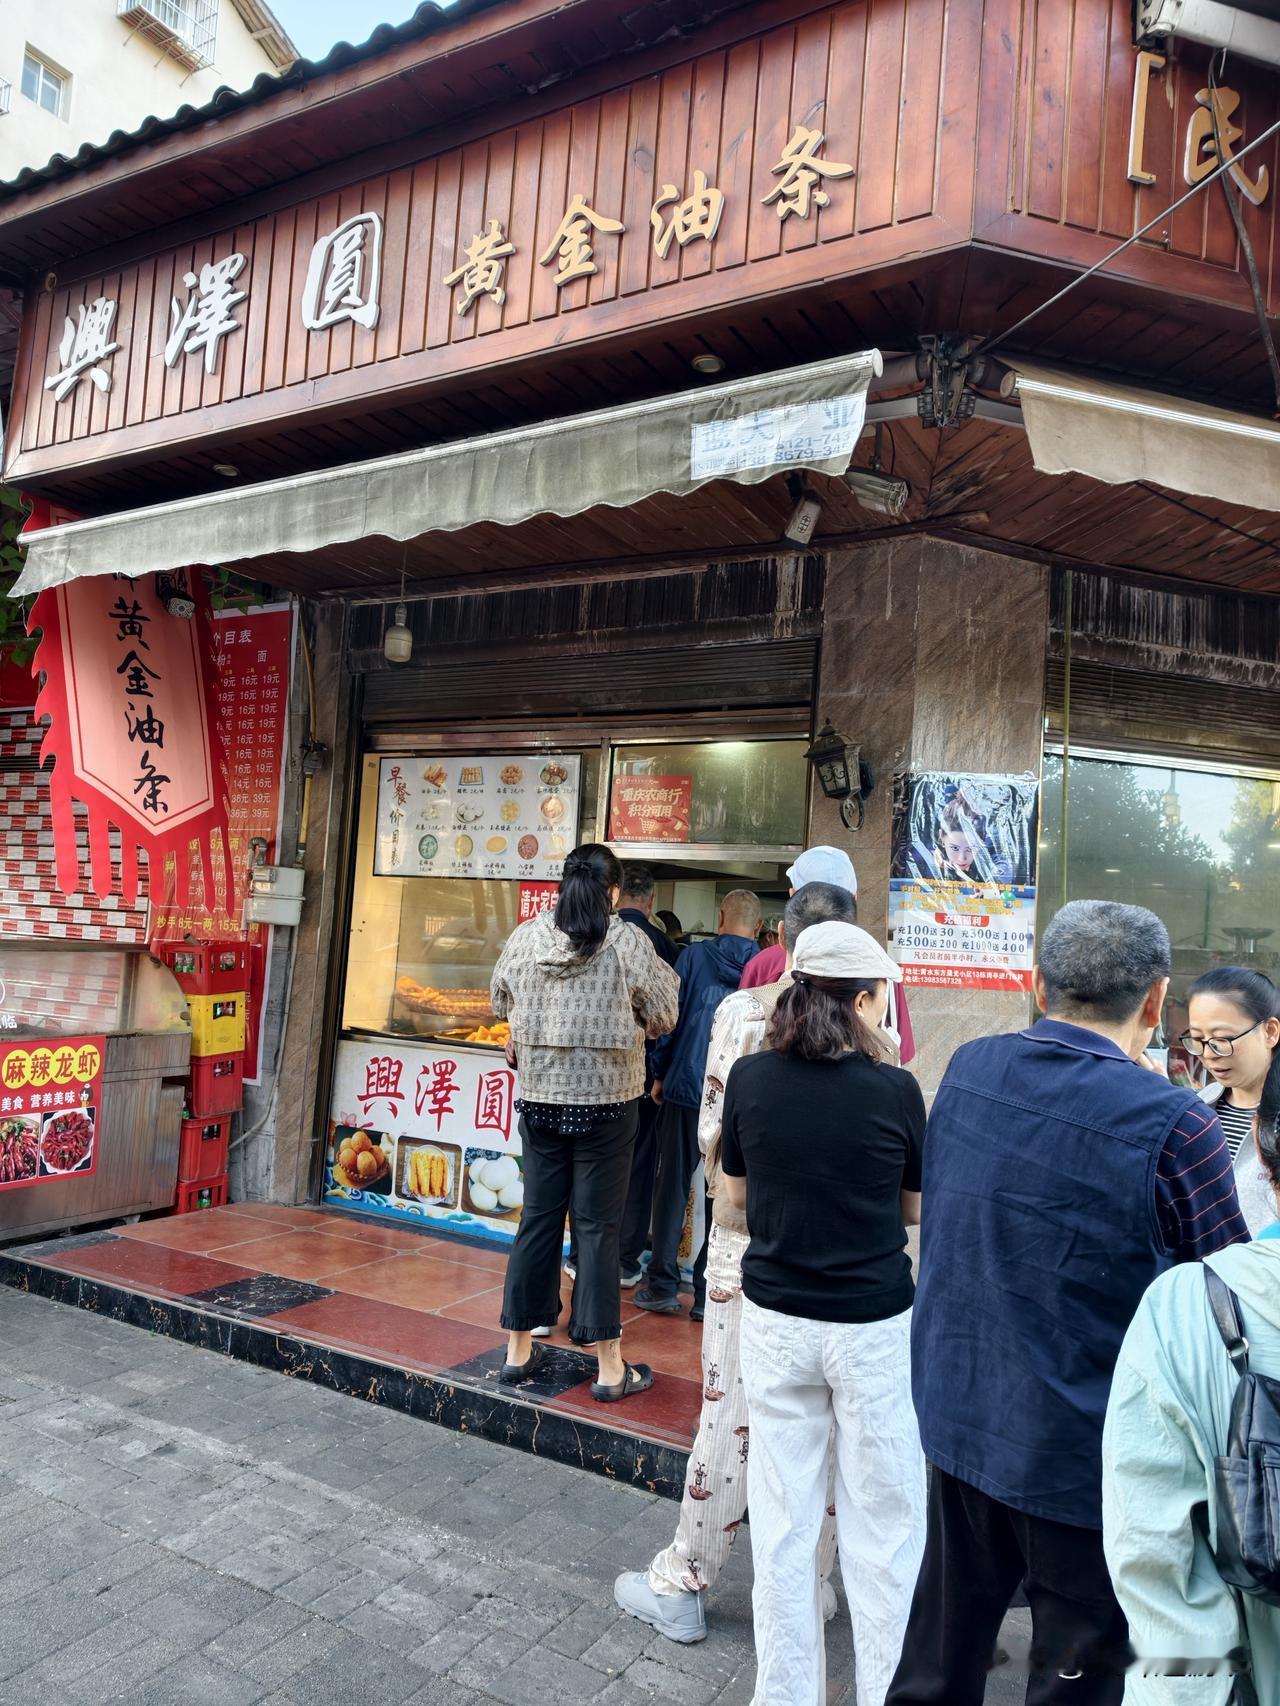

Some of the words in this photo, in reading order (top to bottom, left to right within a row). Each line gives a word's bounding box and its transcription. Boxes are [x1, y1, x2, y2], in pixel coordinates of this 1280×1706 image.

[443, 126, 855, 316] 黄金油条
[220, 676, 236, 687] 9元
[241, 674, 258, 686] 16元
[262, 673, 280, 684] 19元
[240, 689, 257, 700] 16元
[261, 687, 279, 698] 19元
[239, 704, 256, 715] 16元
[260, 702, 278, 713] 19元
[238, 719, 255, 730] 16元
[259, 717, 276, 728] 19元
[236, 734, 253, 744] 16元
[257, 732, 275, 743] 19元
[235, 748, 252, 759] 16元
[257, 747, 274, 758] 19元
[234, 763, 251, 774] 16元
[256, 762, 273, 773] 19元
[255, 777, 272, 788] 16元
[620, 787, 683, 806] 重庆农商行
[627, 802, 673, 818] 积分可用
[0, 1015, 17, 1030] 临
[5, 1051, 98, 1084] 麻辣龙虾
[1, 1096, 24, 1112] 美食
[30, 1090, 76, 1108] 营养美味
[357, 1056, 517, 1142] 興澤圓
